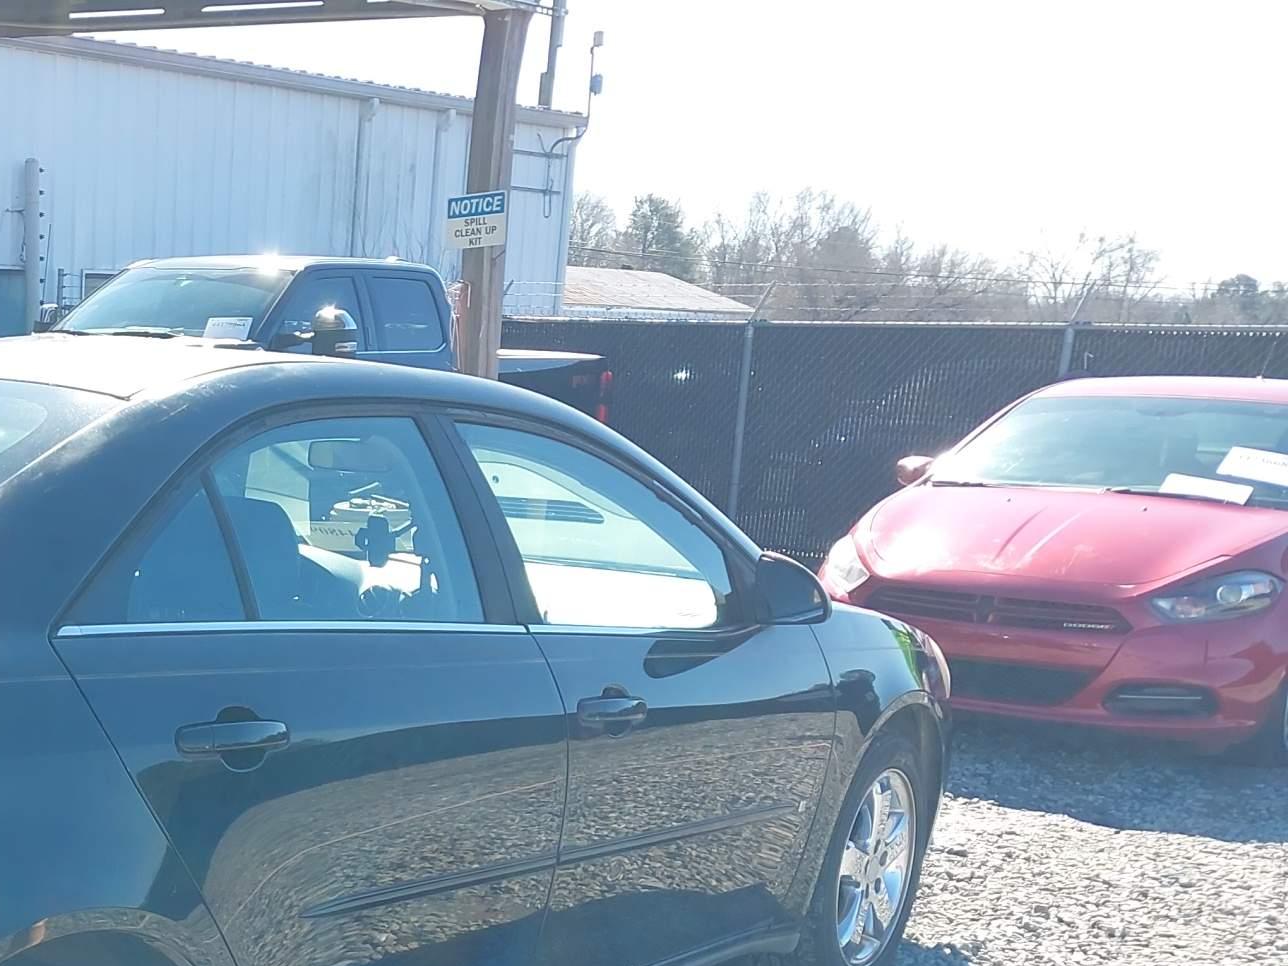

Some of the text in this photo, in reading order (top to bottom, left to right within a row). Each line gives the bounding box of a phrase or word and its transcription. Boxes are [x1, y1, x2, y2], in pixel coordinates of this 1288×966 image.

[449, 195, 503, 216] NOTICE
[464, 217, 487, 227] SPILL
[454, 226, 497, 238] CLEAN UP
[469, 237, 482, 246] KIT
